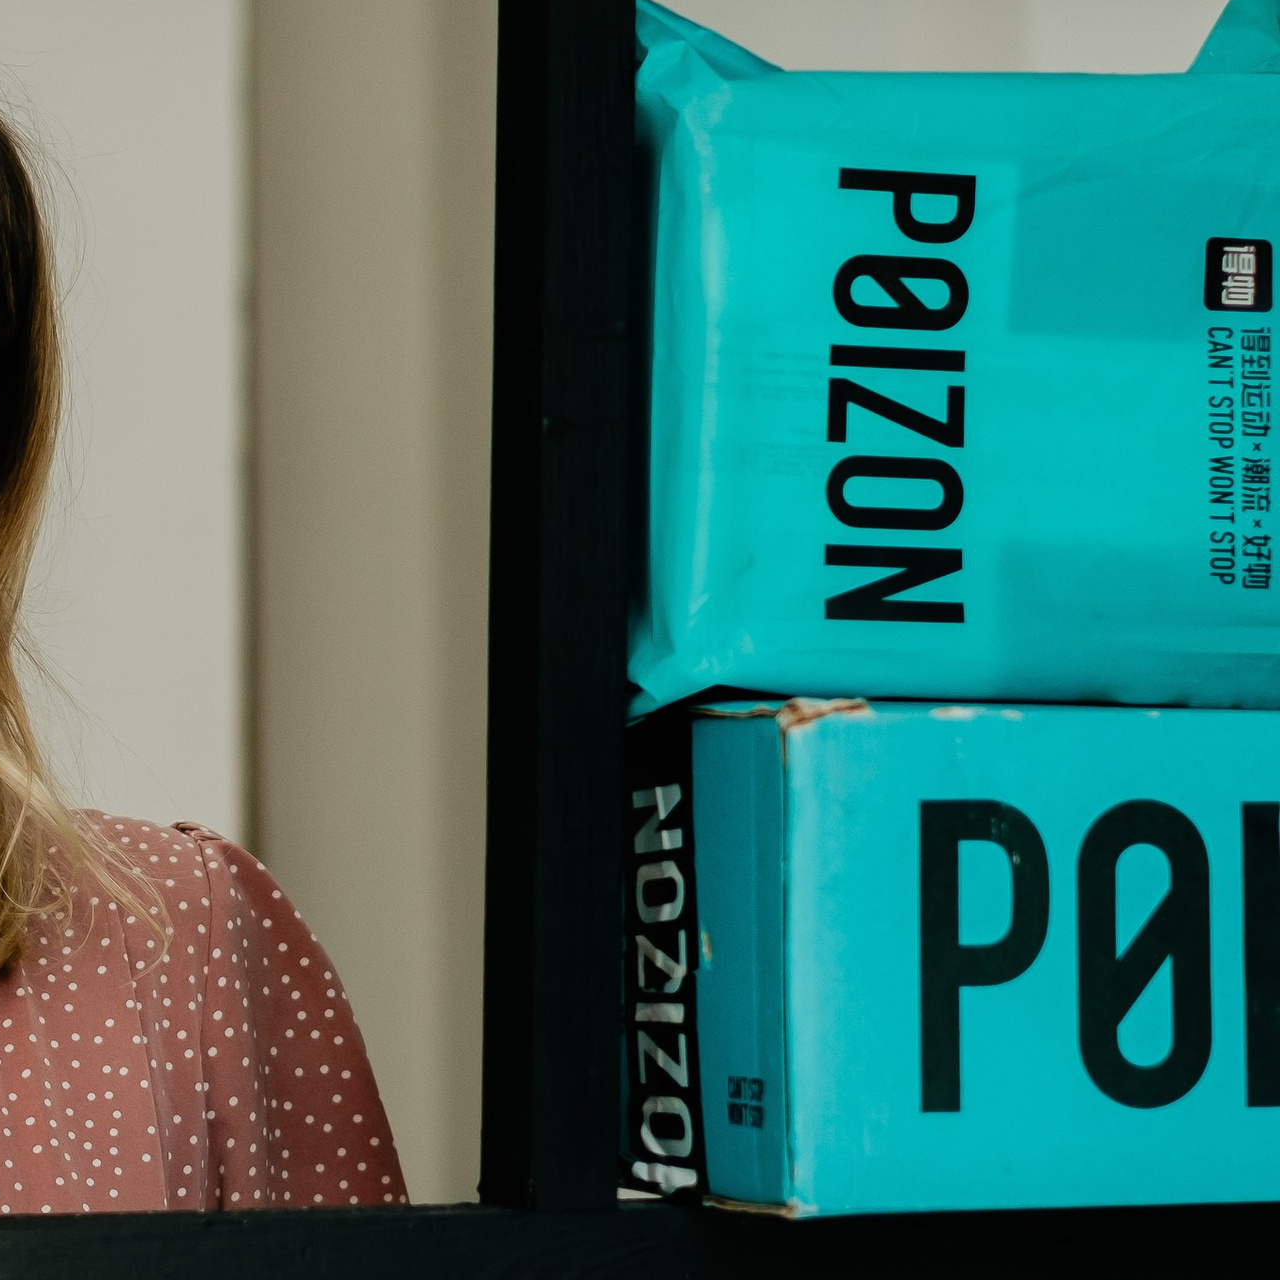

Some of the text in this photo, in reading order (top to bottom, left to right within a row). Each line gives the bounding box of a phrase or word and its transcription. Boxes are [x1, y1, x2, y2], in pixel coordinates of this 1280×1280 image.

[1207, 326, 1236, 585] CAN'T STOP WON'T STOP
